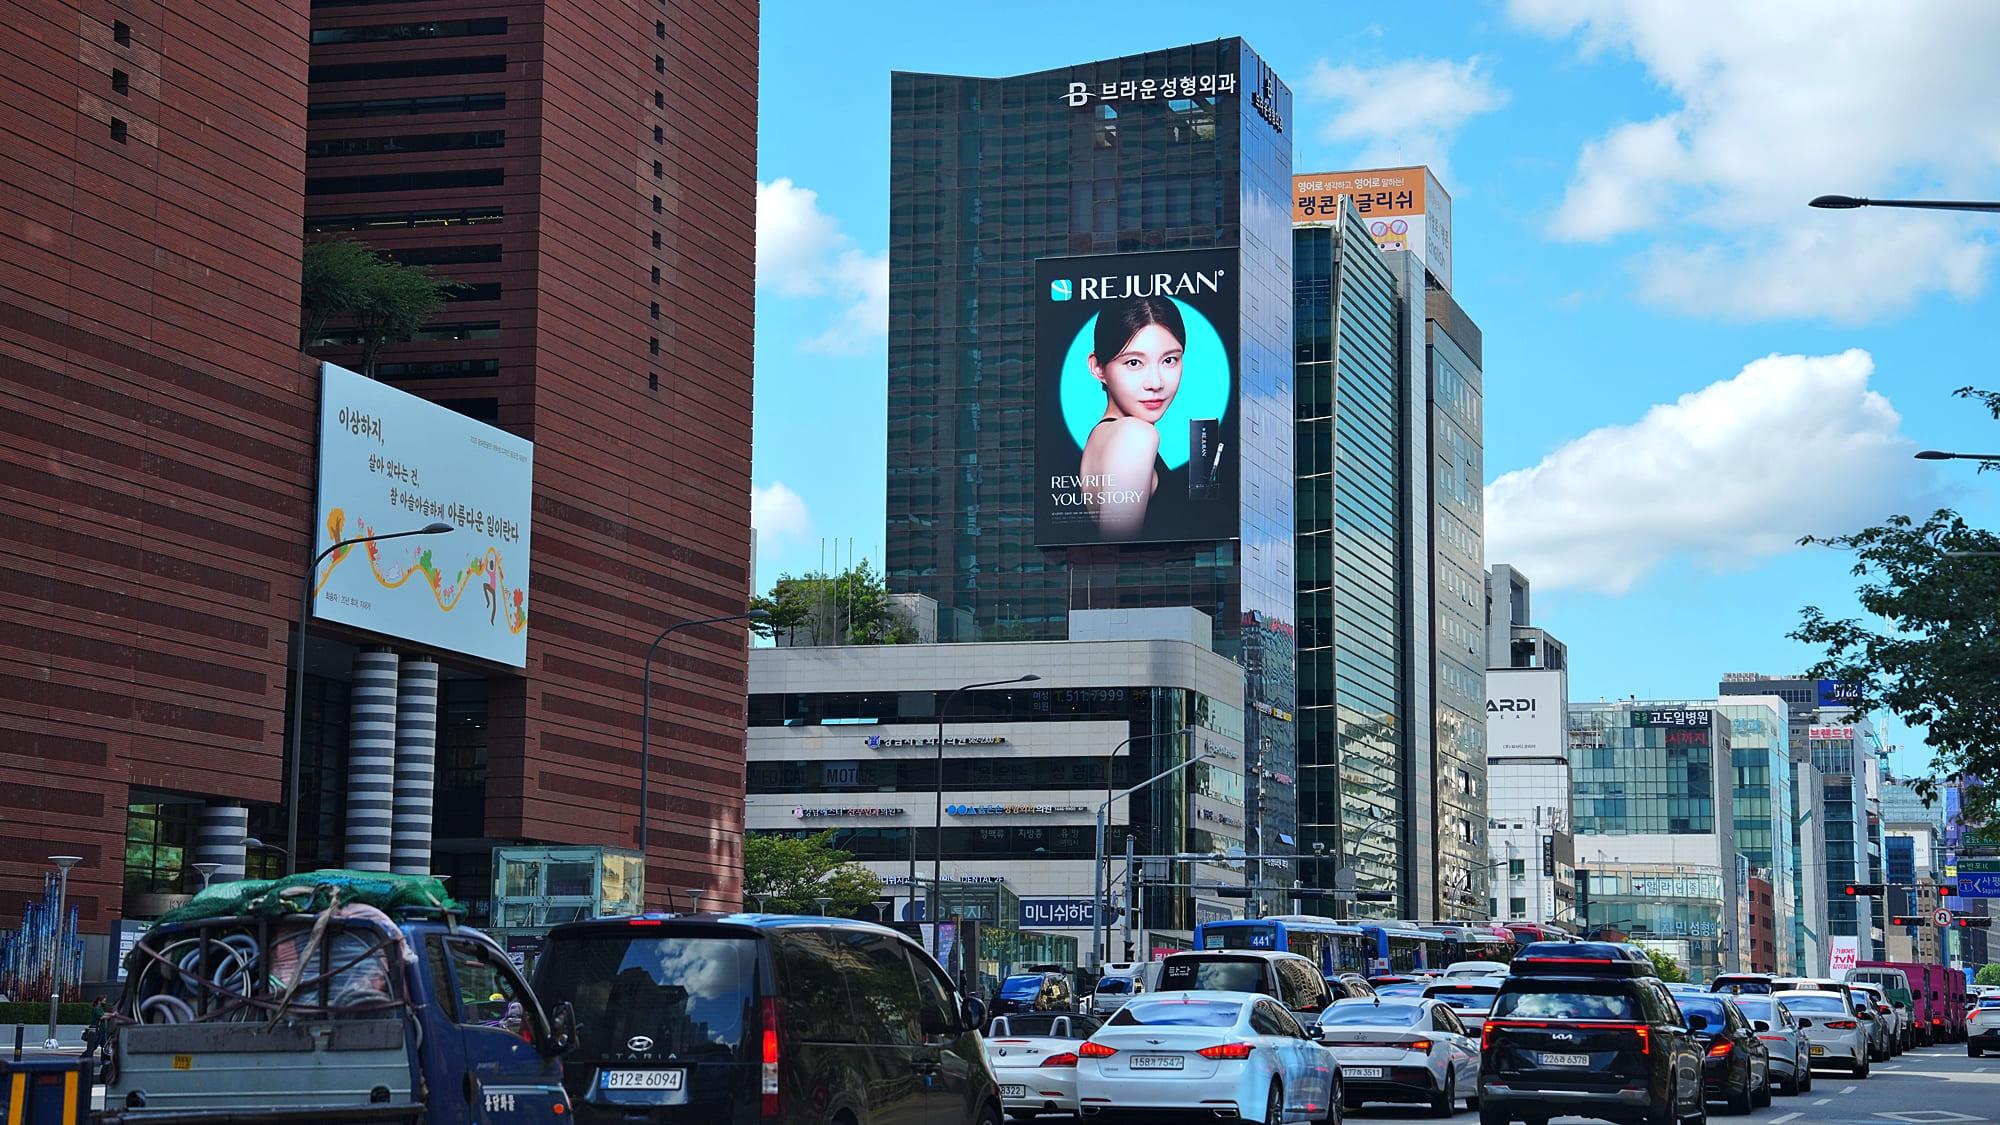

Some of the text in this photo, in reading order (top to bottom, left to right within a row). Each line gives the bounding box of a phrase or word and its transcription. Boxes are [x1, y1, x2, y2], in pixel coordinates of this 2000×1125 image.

[1101, 74, 1237, 101] 브라운성형외과
[1298, 181, 1323, 192] 영어로
[1354, 177, 1380, 189] 영어로
[1299, 190, 1413, 216] 랭콘글리쉬
[339, 406, 385, 447] 이상하지,
[368, 453, 420, 488] 살아 있다는 건,
[1051, 474, 1117, 489] REWRITE
[1051, 490, 1144, 506] YOUR STORY
[390, 487, 520, 544] 참 아슬아슬하게 아름다운 일이란다
[1650, 711, 1709, 725] 고도일병원
[1252, 935, 1270, 947] 441
[1833, 954, 1855, 963] tvN
[601, 1052, 678, 1060] STARIA
[611, 1072, 678, 1086] 812로 6094
